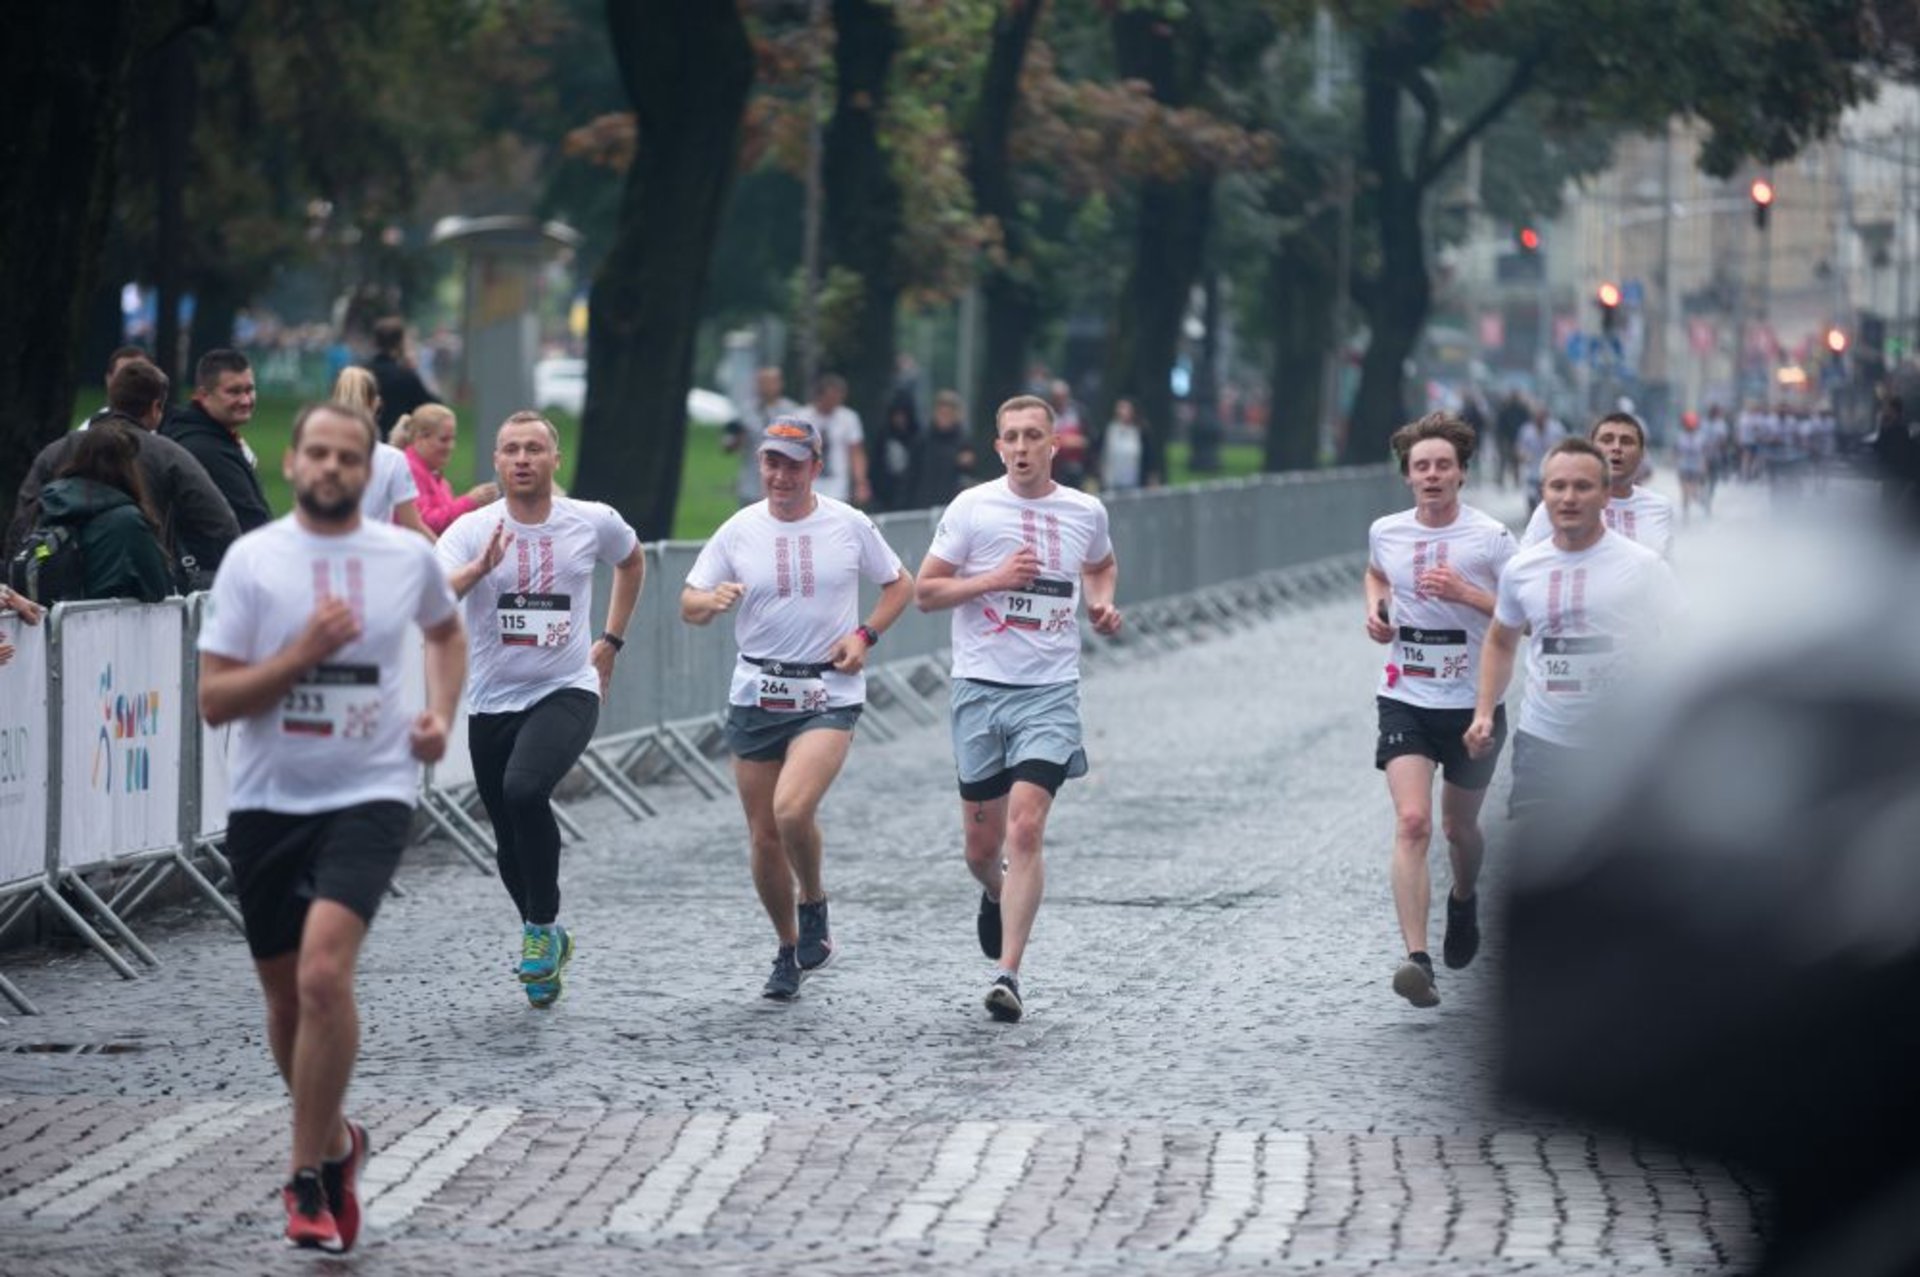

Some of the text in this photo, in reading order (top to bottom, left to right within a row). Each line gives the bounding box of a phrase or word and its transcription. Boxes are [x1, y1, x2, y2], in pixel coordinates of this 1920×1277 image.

[1008, 596, 1032, 613] 191
[501, 614, 525, 629] 115
[1403, 646, 1423, 661] 116
[1546, 660, 1569, 675] 162
[761, 680, 788, 694] 264
